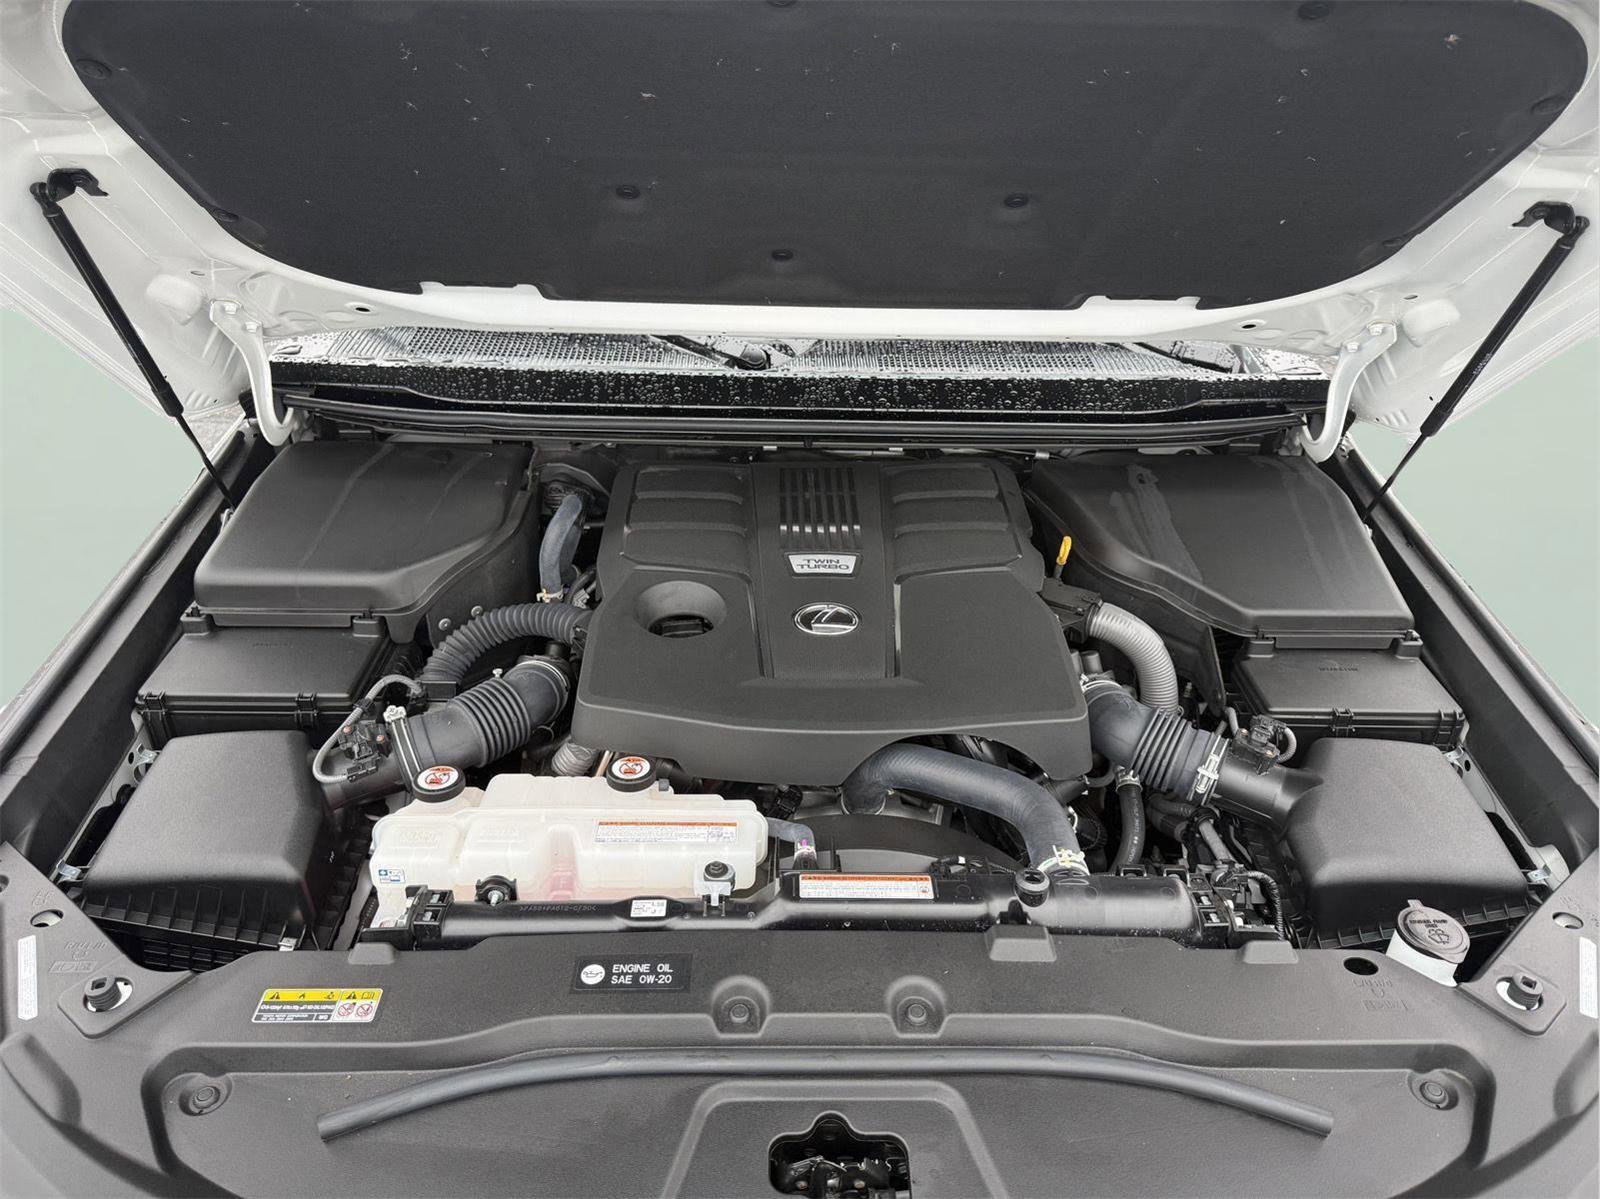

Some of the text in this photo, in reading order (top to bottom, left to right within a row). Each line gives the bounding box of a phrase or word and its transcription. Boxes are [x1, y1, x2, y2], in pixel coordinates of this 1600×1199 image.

[612, 963, 674, 973] ENGINE OIL
[611, 974, 672, 984] SAE 0W-20
